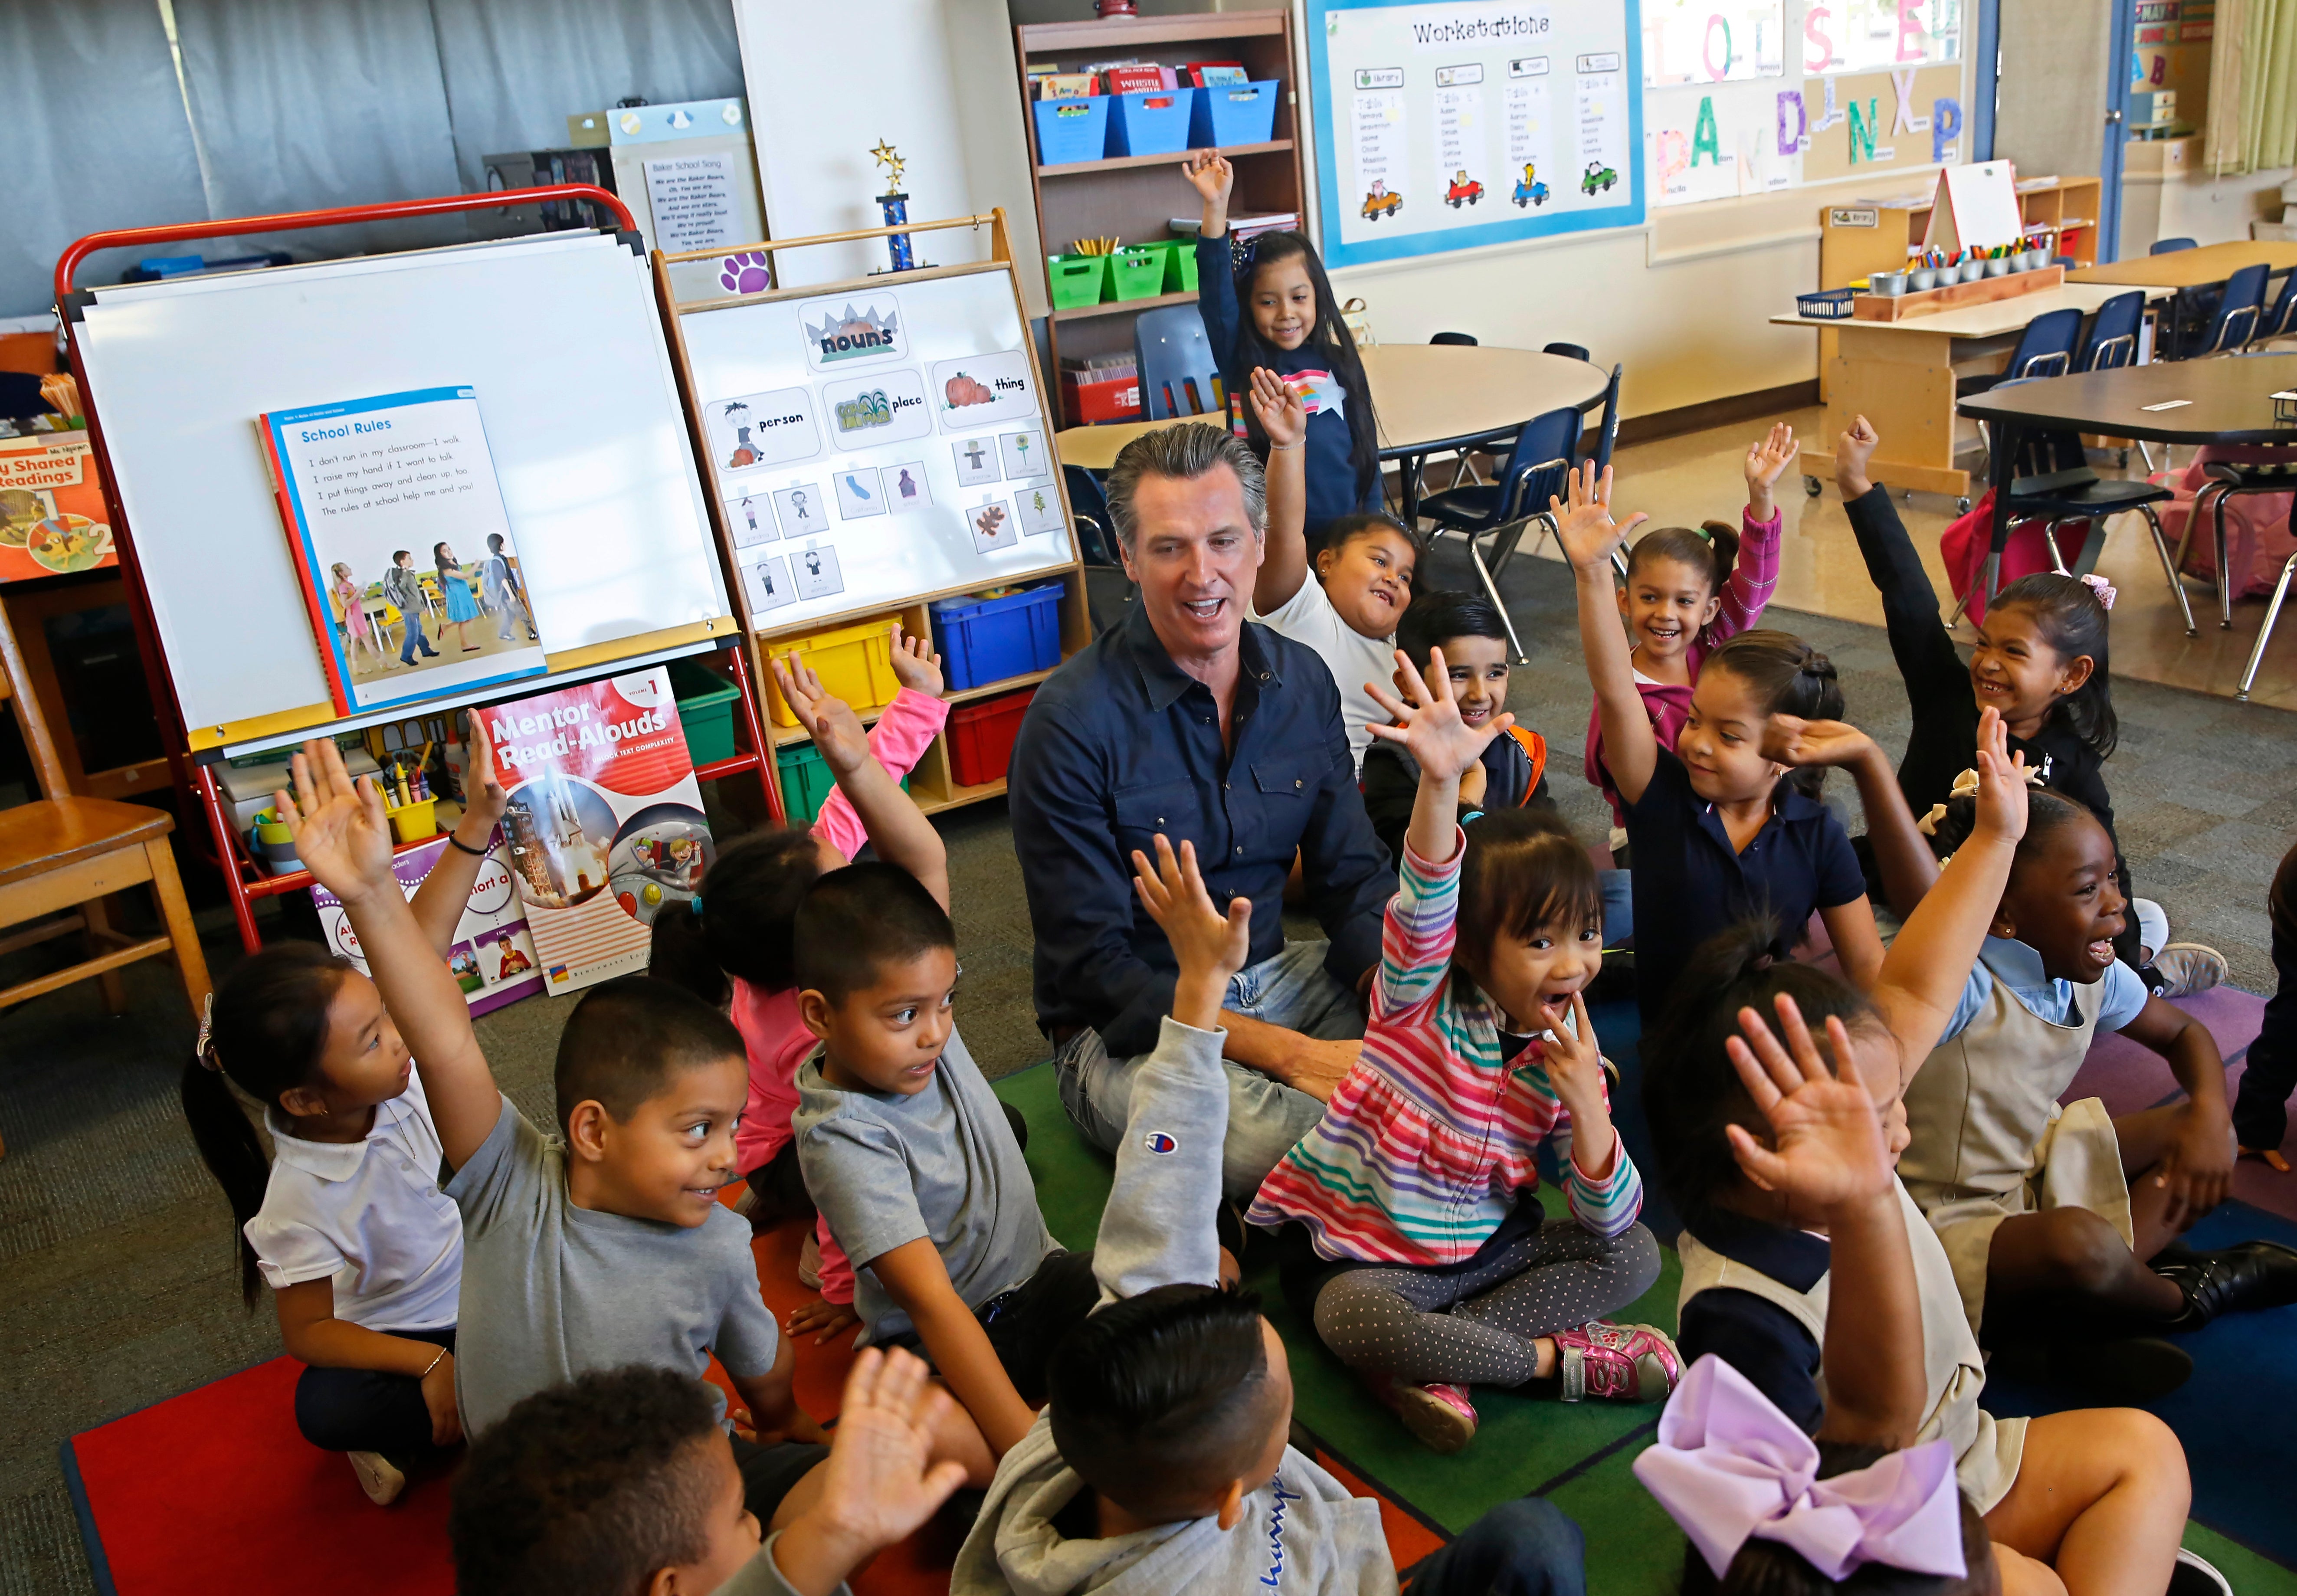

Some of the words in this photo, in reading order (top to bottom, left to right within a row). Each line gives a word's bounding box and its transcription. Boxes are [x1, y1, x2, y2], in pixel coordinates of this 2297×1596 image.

[1414, 16, 1549, 43] Workstations
[1804, 7, 1833, 72] S
[2149, 55, 2166, 85] B
[1890, 69, 1917, 137] X
[1690, 96, 1720, 167] A
[1777, 91, 1806, 156] D
[1848, 96, 1878, 164] N
[1933, 98, 1963, 163] P
[675, 160, 700, 170] School
[702, 160, 722, 169] Song
[821, 329, 893, 354] nouns
[995, 377, 1025, 391] thing
[891, 396, 923, 413] place
[301, 425, 350, 443] School
[354, 419, 392, 434] Rules
[759, 413, 804, 433] person
[0, 463, 10, 476] y
[13, 456, 76, 472] Shared
[309, 459, 315, 468] I
[319, 456, 339, 466] don't
[313, 475, 319, 484] I
[323, 473, 343, 482] raise
[347, 471, 359, 479] my
[362, 463, 383, 475] hand
[387, 462, 393, 470] if
[396, 461, 402, 469] I
[406, 457, 425, 467] want
[318, 492, 323, 500] I
[328, 489, 341, 500] put
[344, 486, 368, 495] things
[371, 481, 393, 489] away
[397, 475, 413, 485] and
[416, 473, 437, 482] clean
[321, 507, 337, 516] The
[341, 503, 360, 513] rules
[363, 500, 371, 508] at
[375, 493, 400, 506] school
[403, 491, 420, 501] help
[439, 484, 455, 495] and
[34, 489, 61, 521] 1
[850, 505, 878, 514] California
[88, 523, 117, 556] 2
[745, 533, 770, 544] grandma
[629, 688, 647, 696] VOLUME
[648, 679, 659, 695] 1
[491, 700, 590, 744] Mentor
[497, 709, 667, 771] Read-Alouds
[592, 752, 619, 764] UNLOCK
[619, 747, 634, 756] TEXT
[635, 736, 675, 752] COMPLEXITY
[499, 875, 509, 884] a
